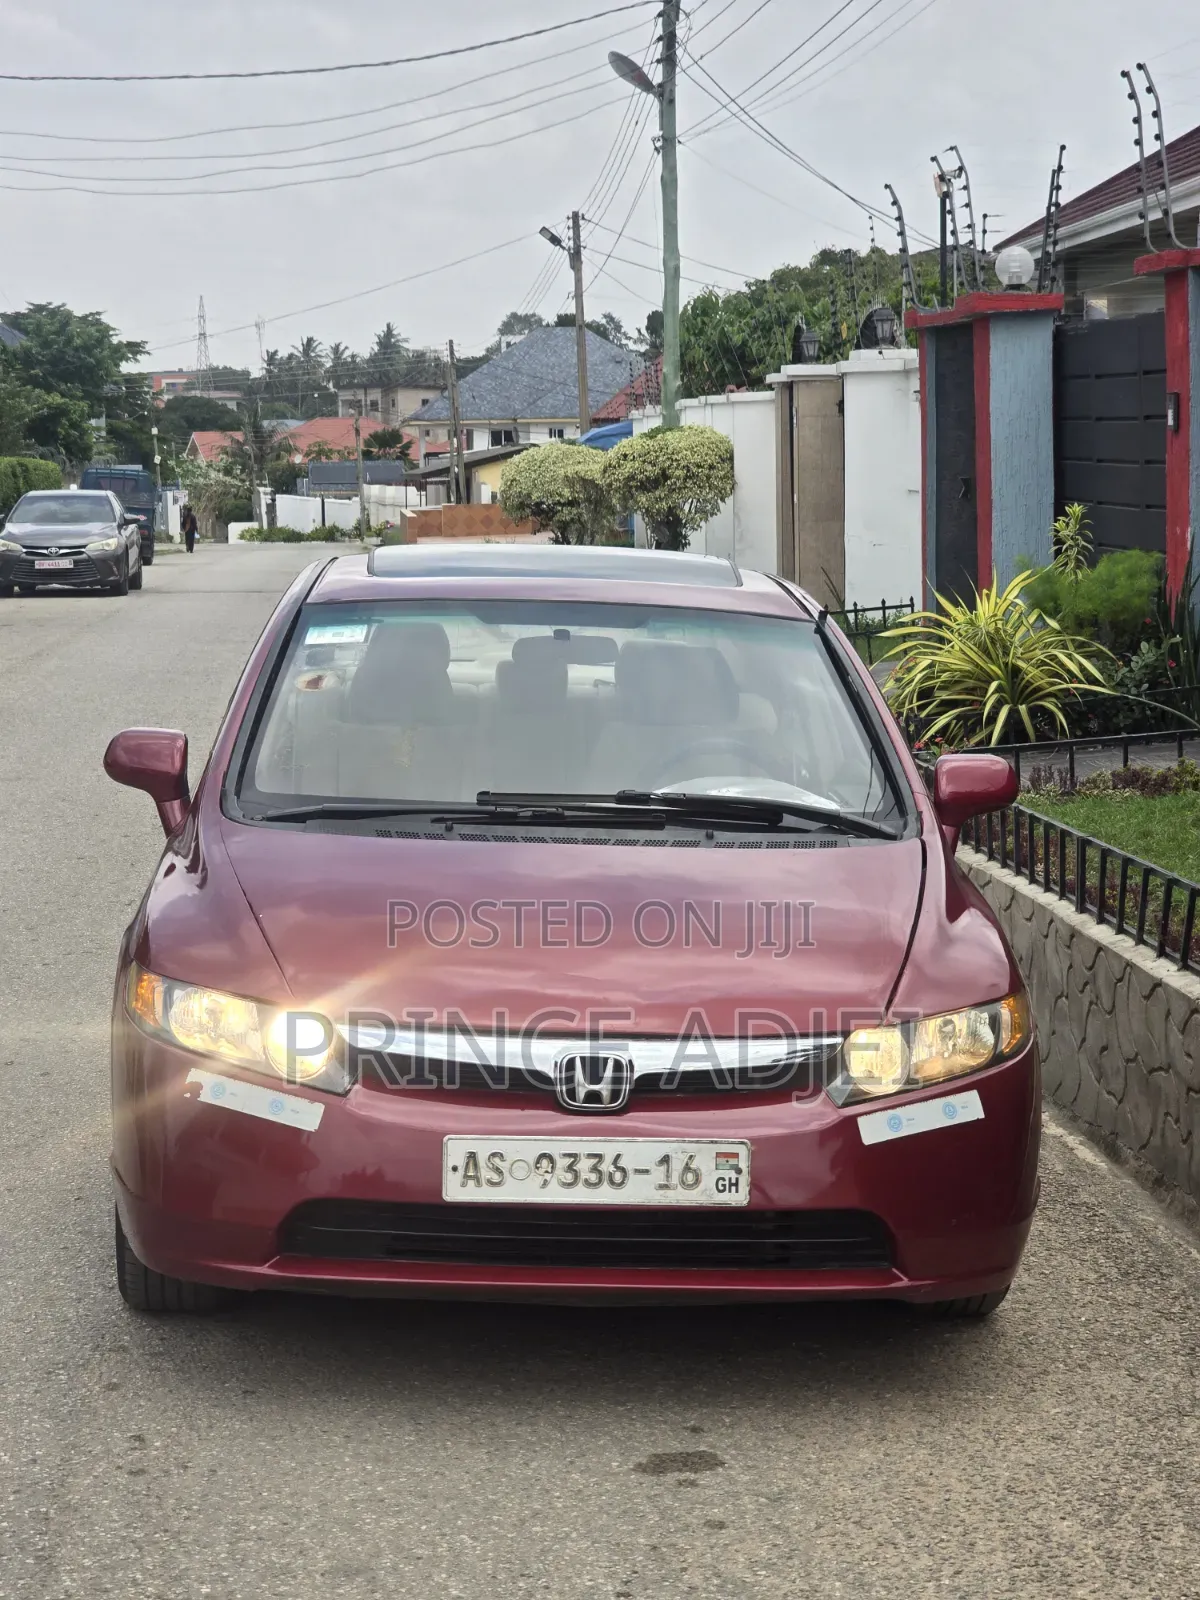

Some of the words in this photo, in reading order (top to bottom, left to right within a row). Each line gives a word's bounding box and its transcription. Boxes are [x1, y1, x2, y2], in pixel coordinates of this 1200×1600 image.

[459, 1150, 507, 1188] AS
[533, 1151, 704, 1191] 9336-16
[715, 1176, 740, 1194] GH
